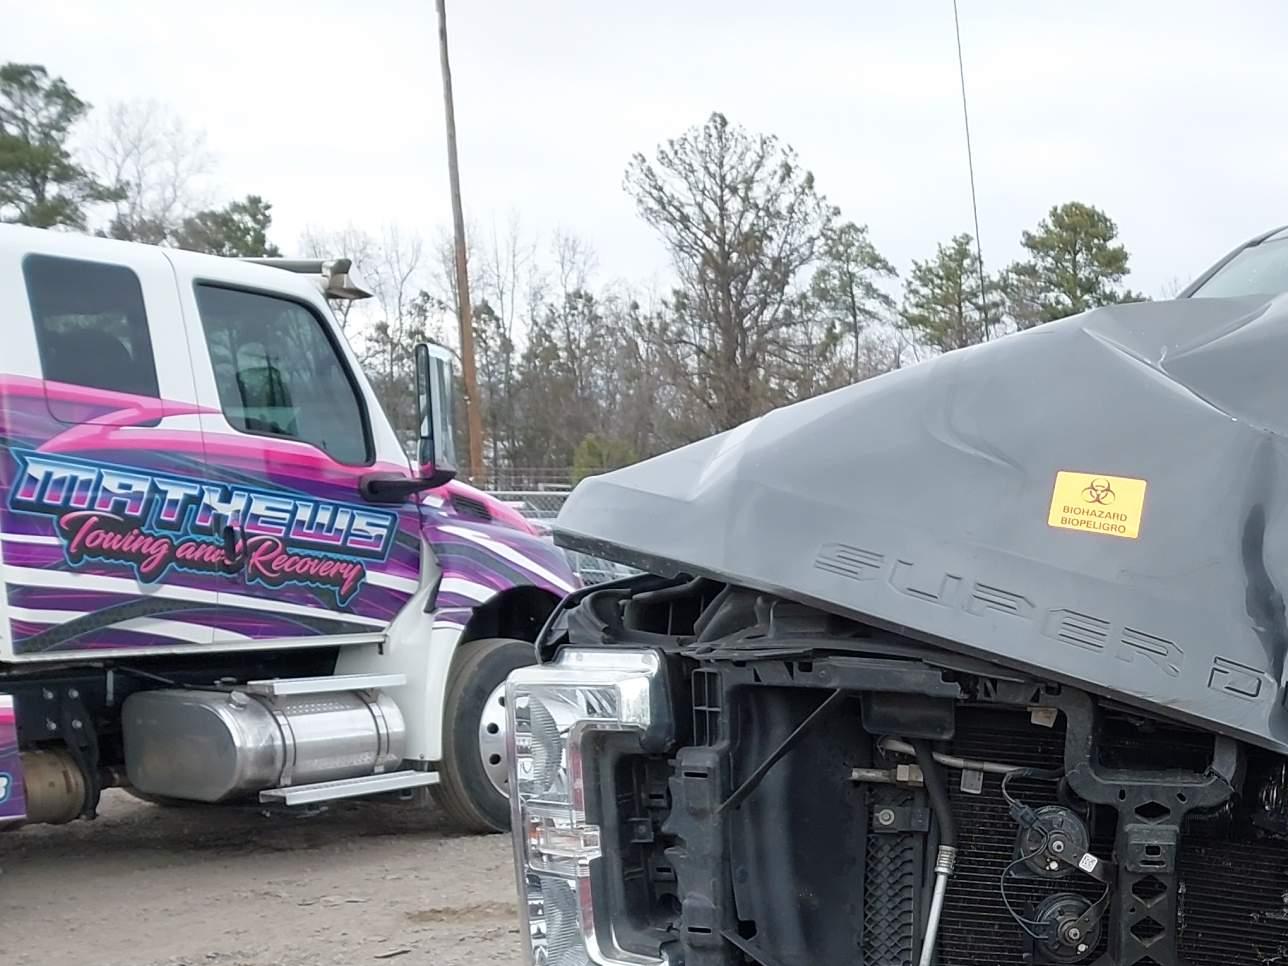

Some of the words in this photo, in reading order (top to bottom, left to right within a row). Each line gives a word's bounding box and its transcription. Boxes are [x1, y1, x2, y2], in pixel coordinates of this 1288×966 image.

[15, 456, 396, 552] MATHEWS
[1060, 516, 1126, 534] BIOPELIGRO
[1062, 505, 1128, 522] BIOHAZARD
[59, 510, 172, 568] Towing
[246, 535, 362, 595] Recovery
[814, 542, 1185, 679] SUPER
